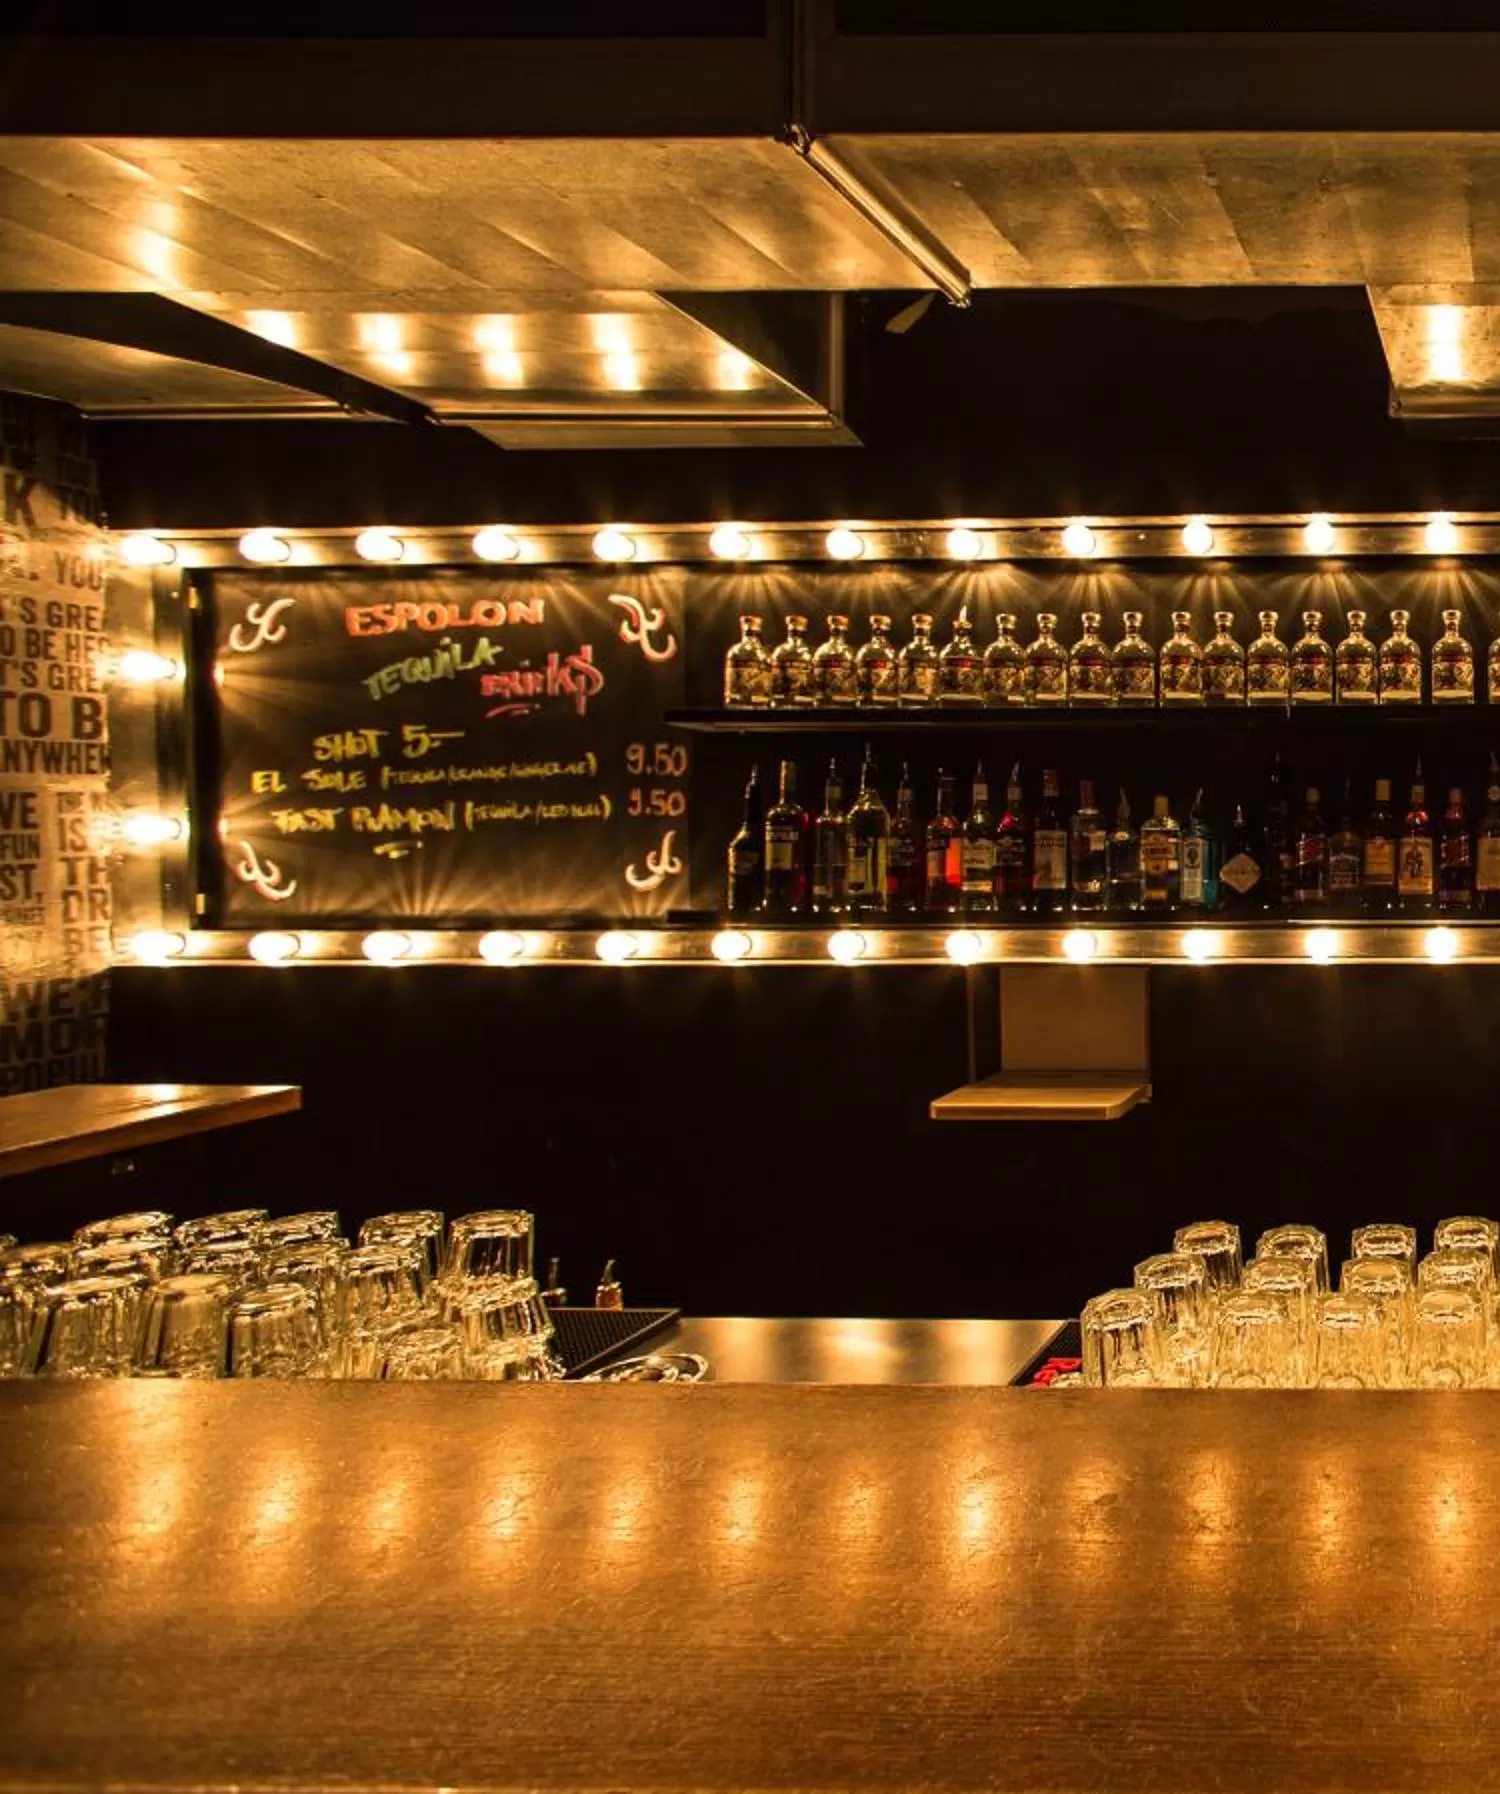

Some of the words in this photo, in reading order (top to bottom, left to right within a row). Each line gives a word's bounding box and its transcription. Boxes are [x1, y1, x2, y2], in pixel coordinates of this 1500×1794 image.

[345, 599, 545, 637] ESPOLON
[25, 628, 57, 661] BE
[313, 729, 388, 761] SHOT
[252, 770, 288, 794] EL
[626, 743, 688, 777] 9.50
